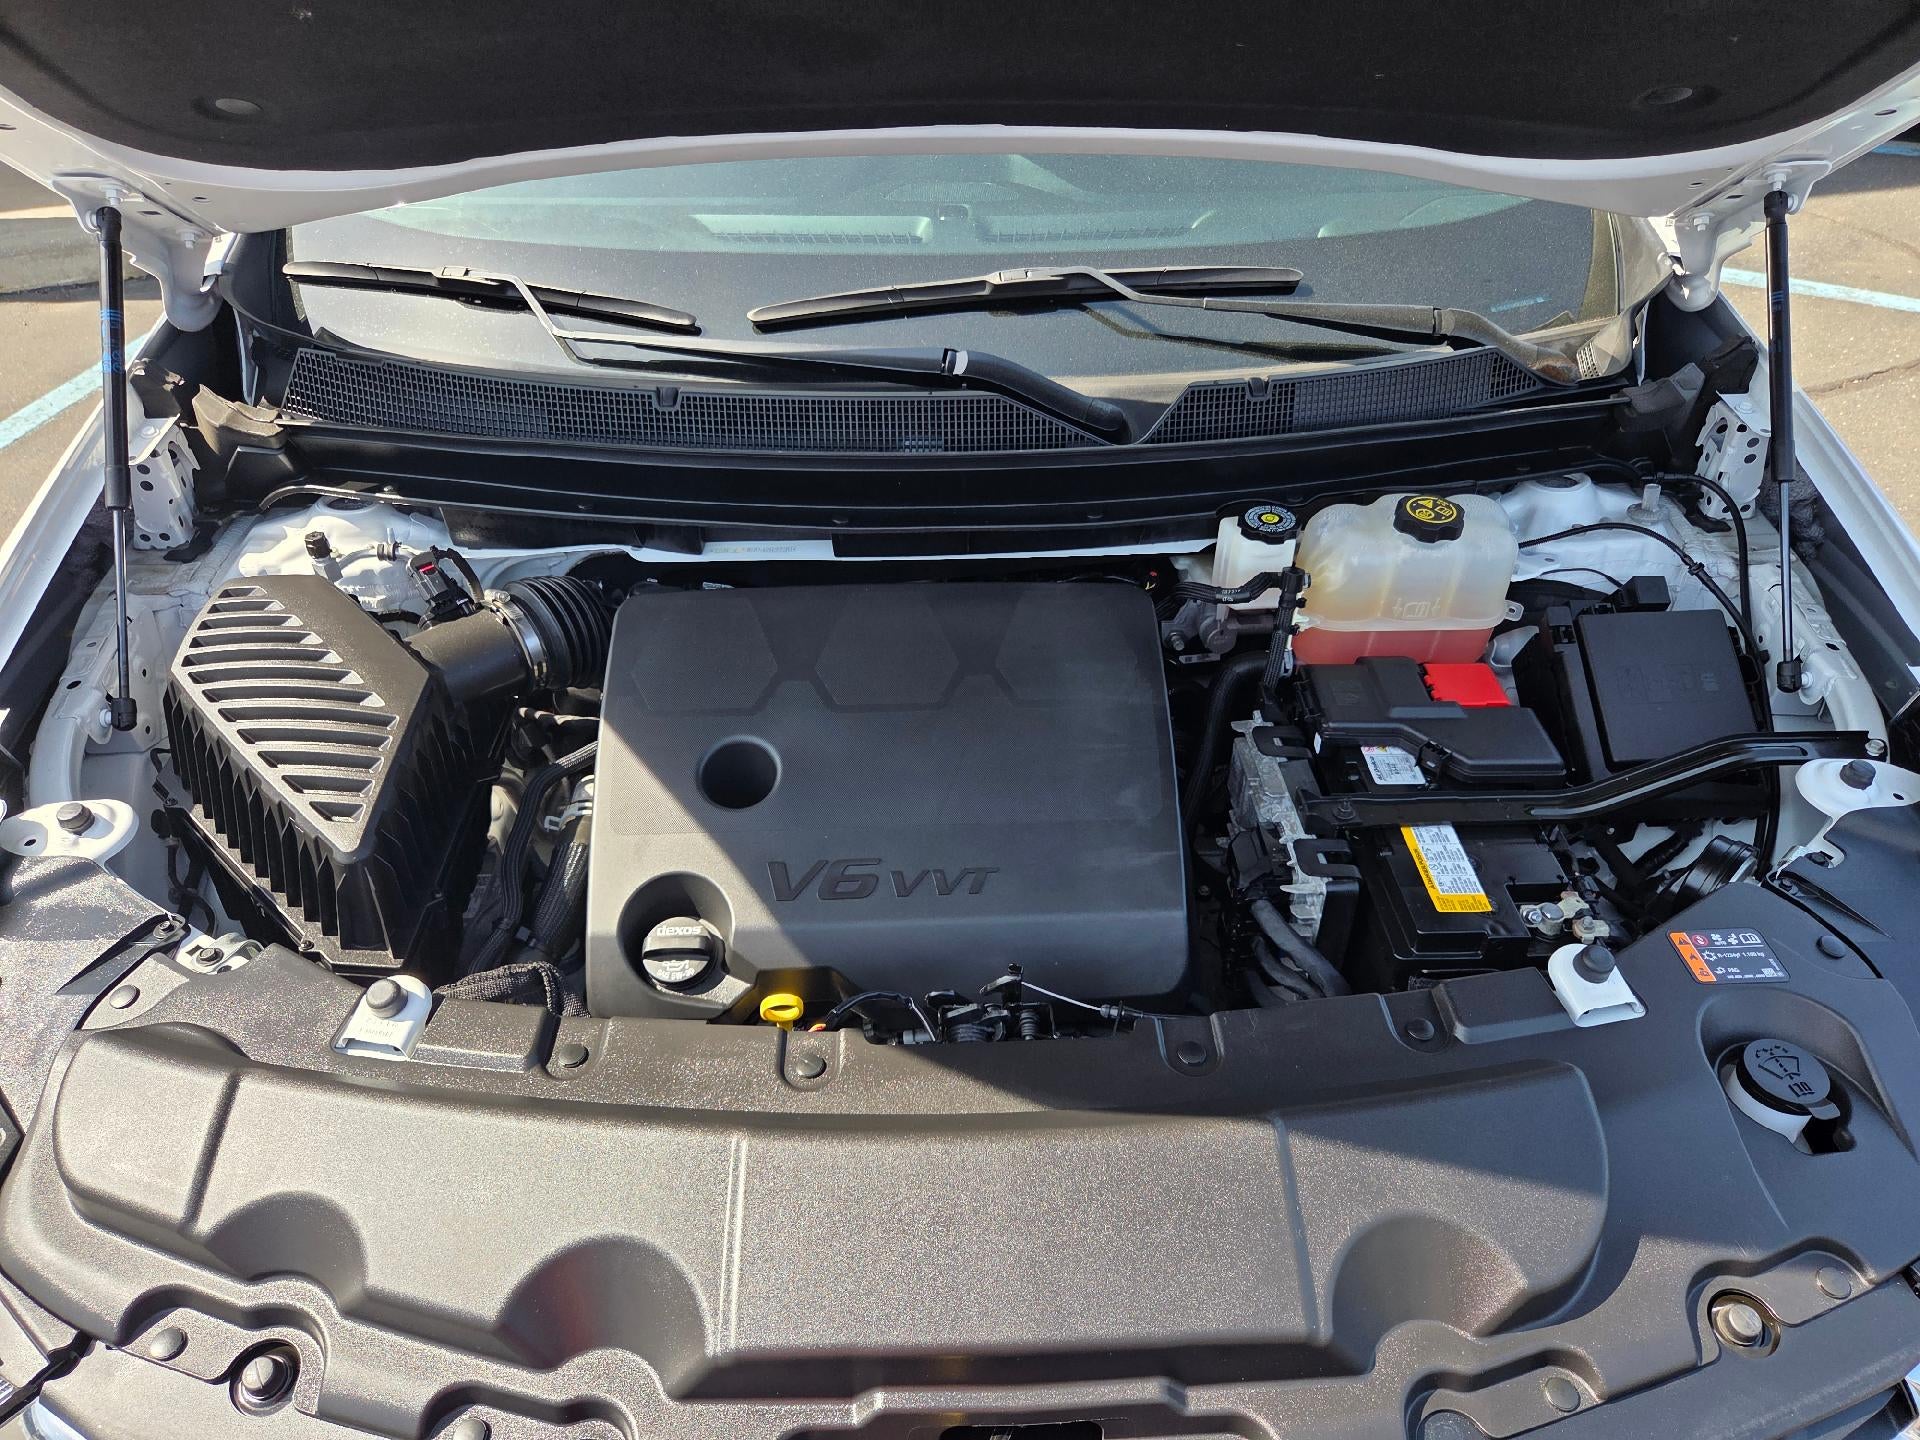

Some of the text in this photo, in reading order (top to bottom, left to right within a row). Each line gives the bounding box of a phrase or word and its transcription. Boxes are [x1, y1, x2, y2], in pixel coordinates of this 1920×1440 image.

[767, 858, 1000, 901] V6 VVT
[656, 925, 702, 937] dexos
